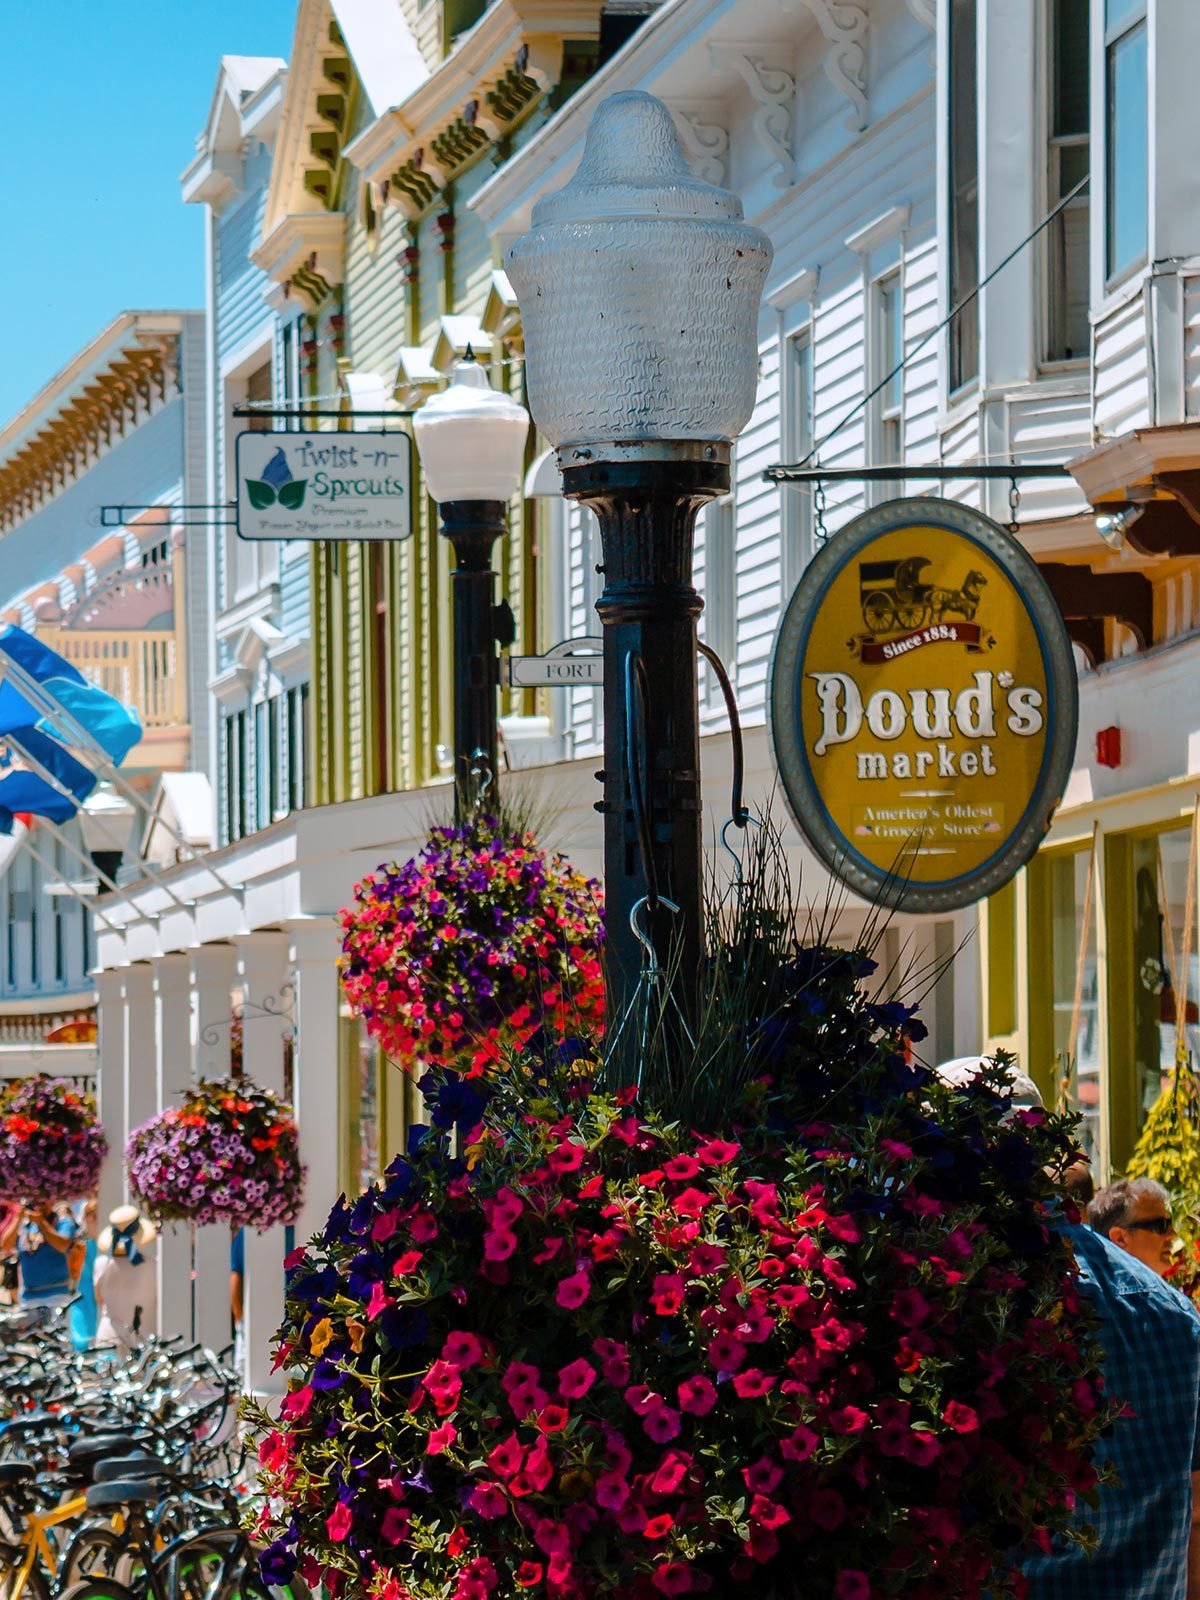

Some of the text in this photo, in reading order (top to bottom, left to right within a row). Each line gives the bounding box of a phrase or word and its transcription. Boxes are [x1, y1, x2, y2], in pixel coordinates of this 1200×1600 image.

[295, 440, 359, 469] Twist
[312, 472, 404, 501] Sprouts
[882, 624, 958, 659] Since 1884
[546, 664, 597, 678] FORT
[806, 670, 1043, 756] Doud's
[856, 742, 997, 779] market
[863, 804, 994, 821] America's Oldest
[943, 822, 982, 836] Store
